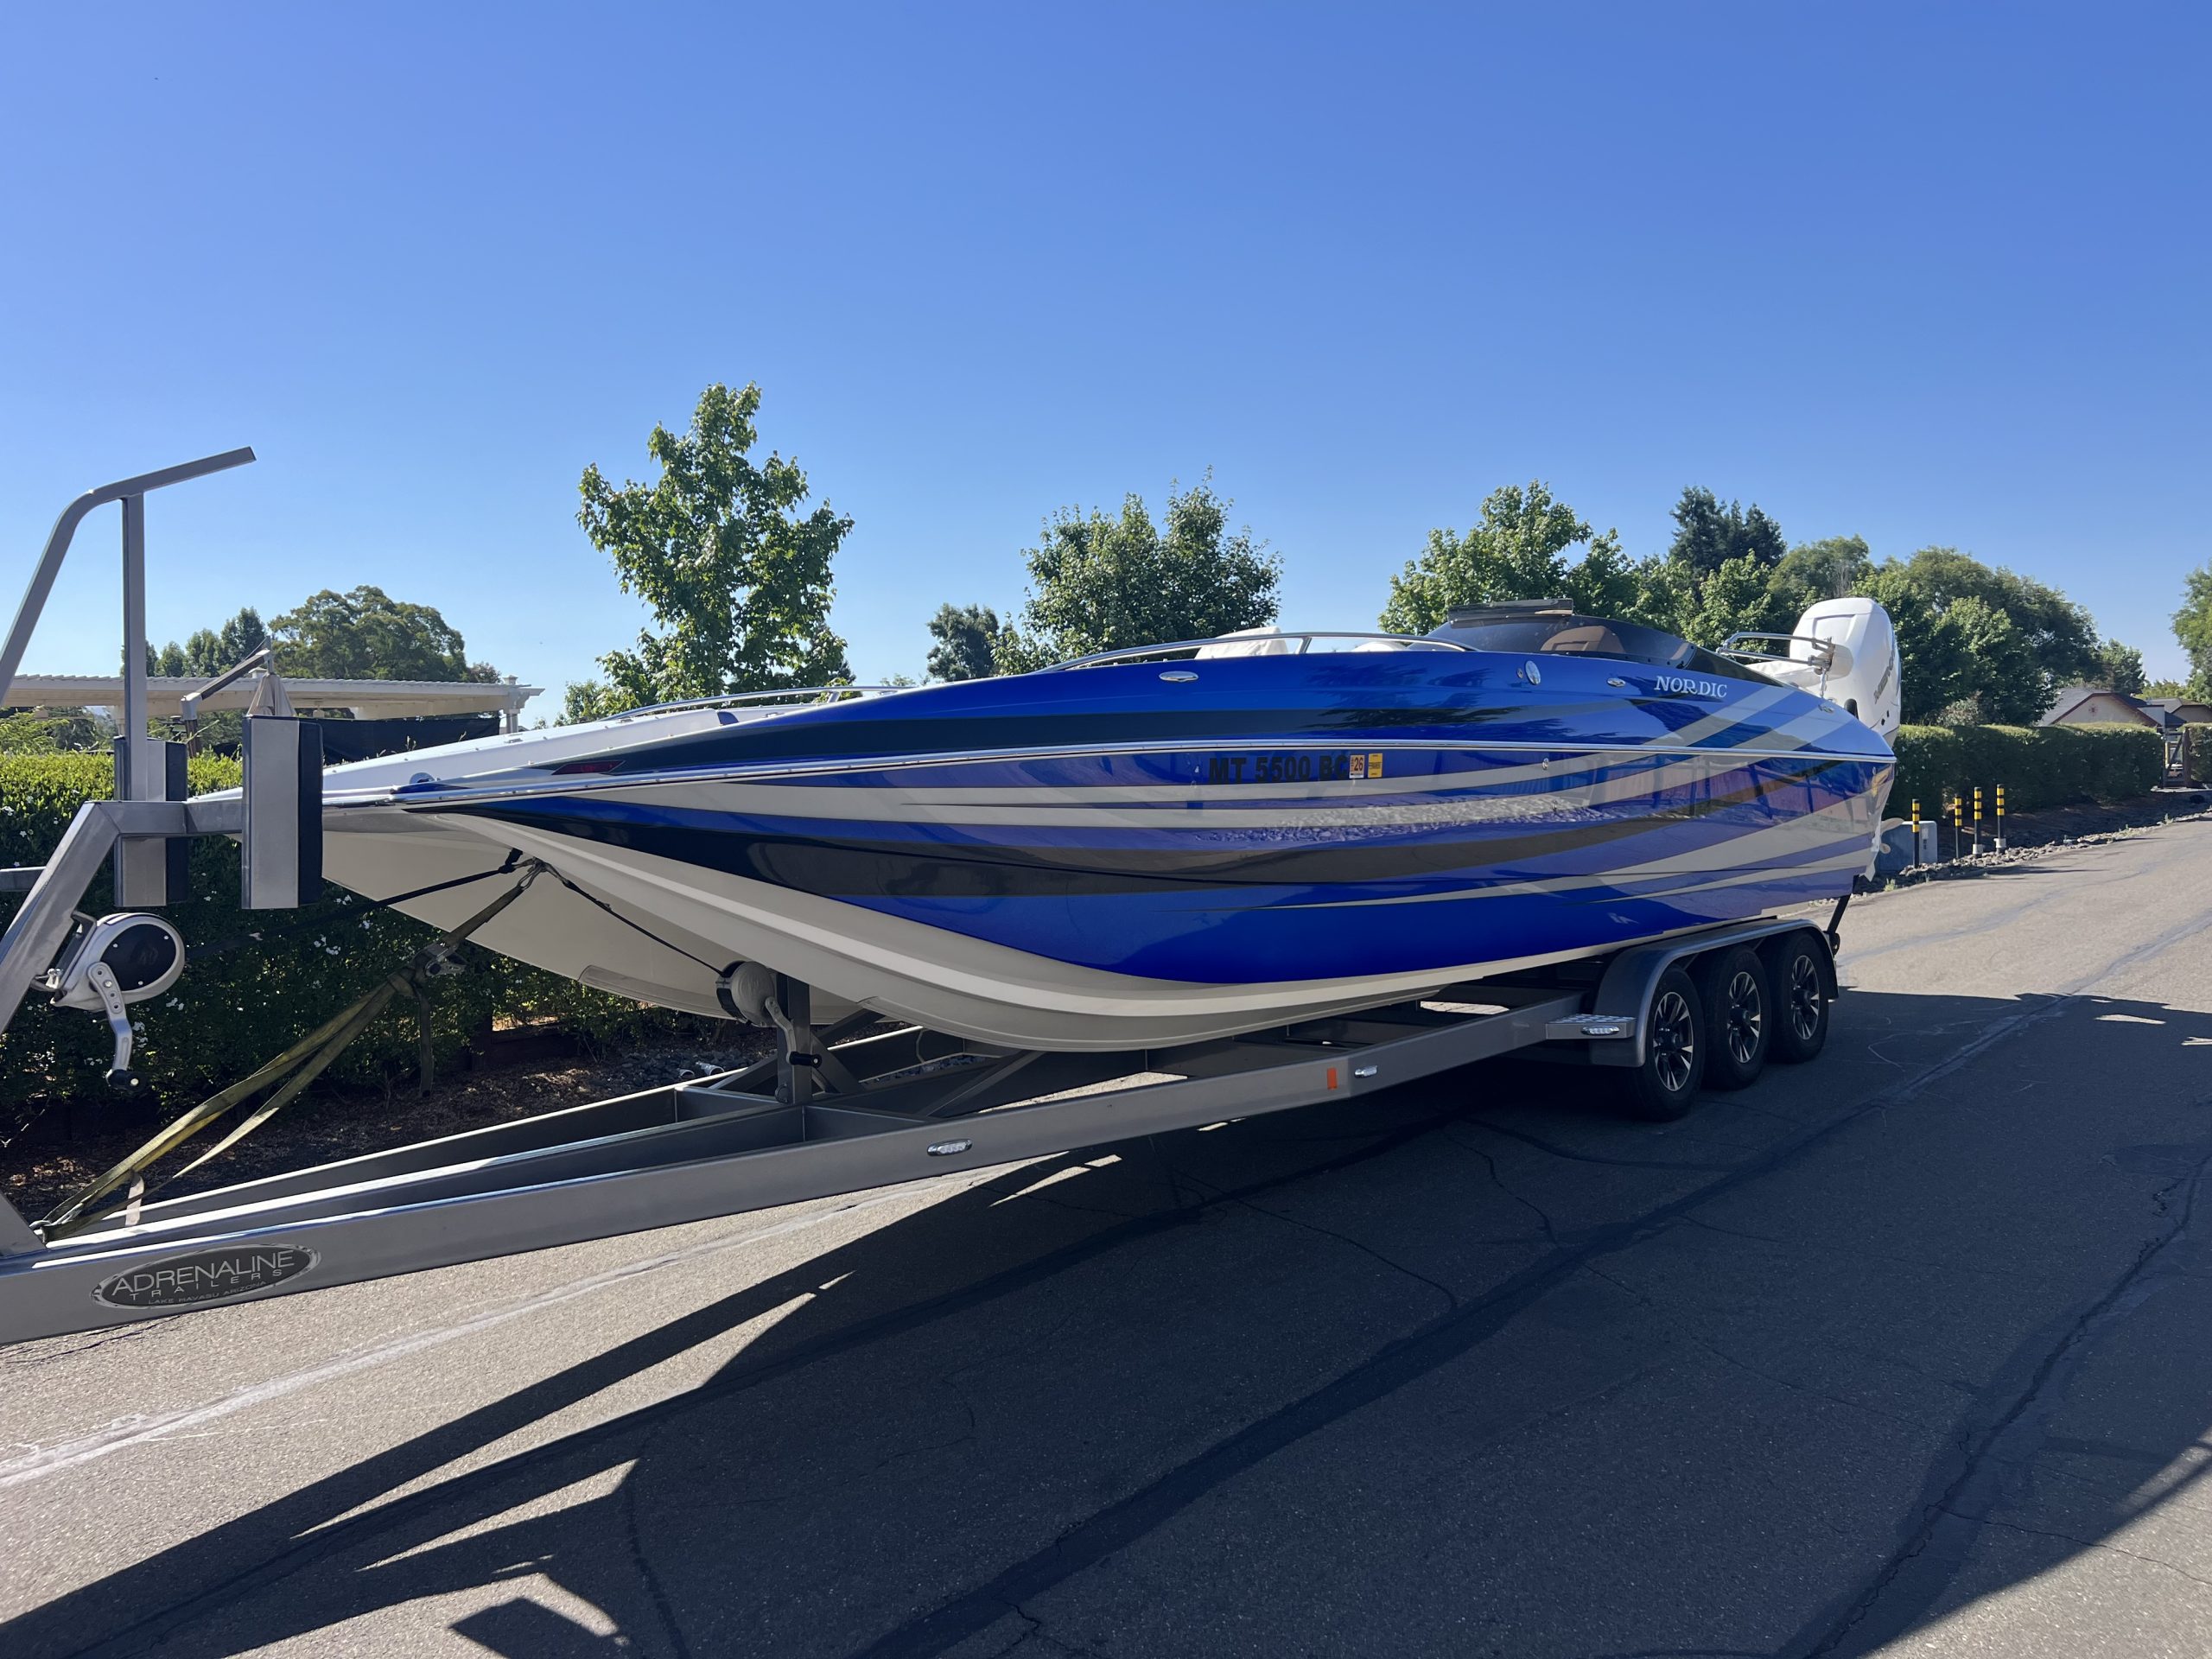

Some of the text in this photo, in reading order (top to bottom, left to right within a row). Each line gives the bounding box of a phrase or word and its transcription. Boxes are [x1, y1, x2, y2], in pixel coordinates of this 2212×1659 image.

[1654, 676, 1727, 697] NORDIC
[1209, 758, 1246, 784] MT
[1354, 757, 1363, 772] 26
[111, 1249, 295, 1295] ADRENALINE
[130, 1268, 283, 1300] TRAILERS
